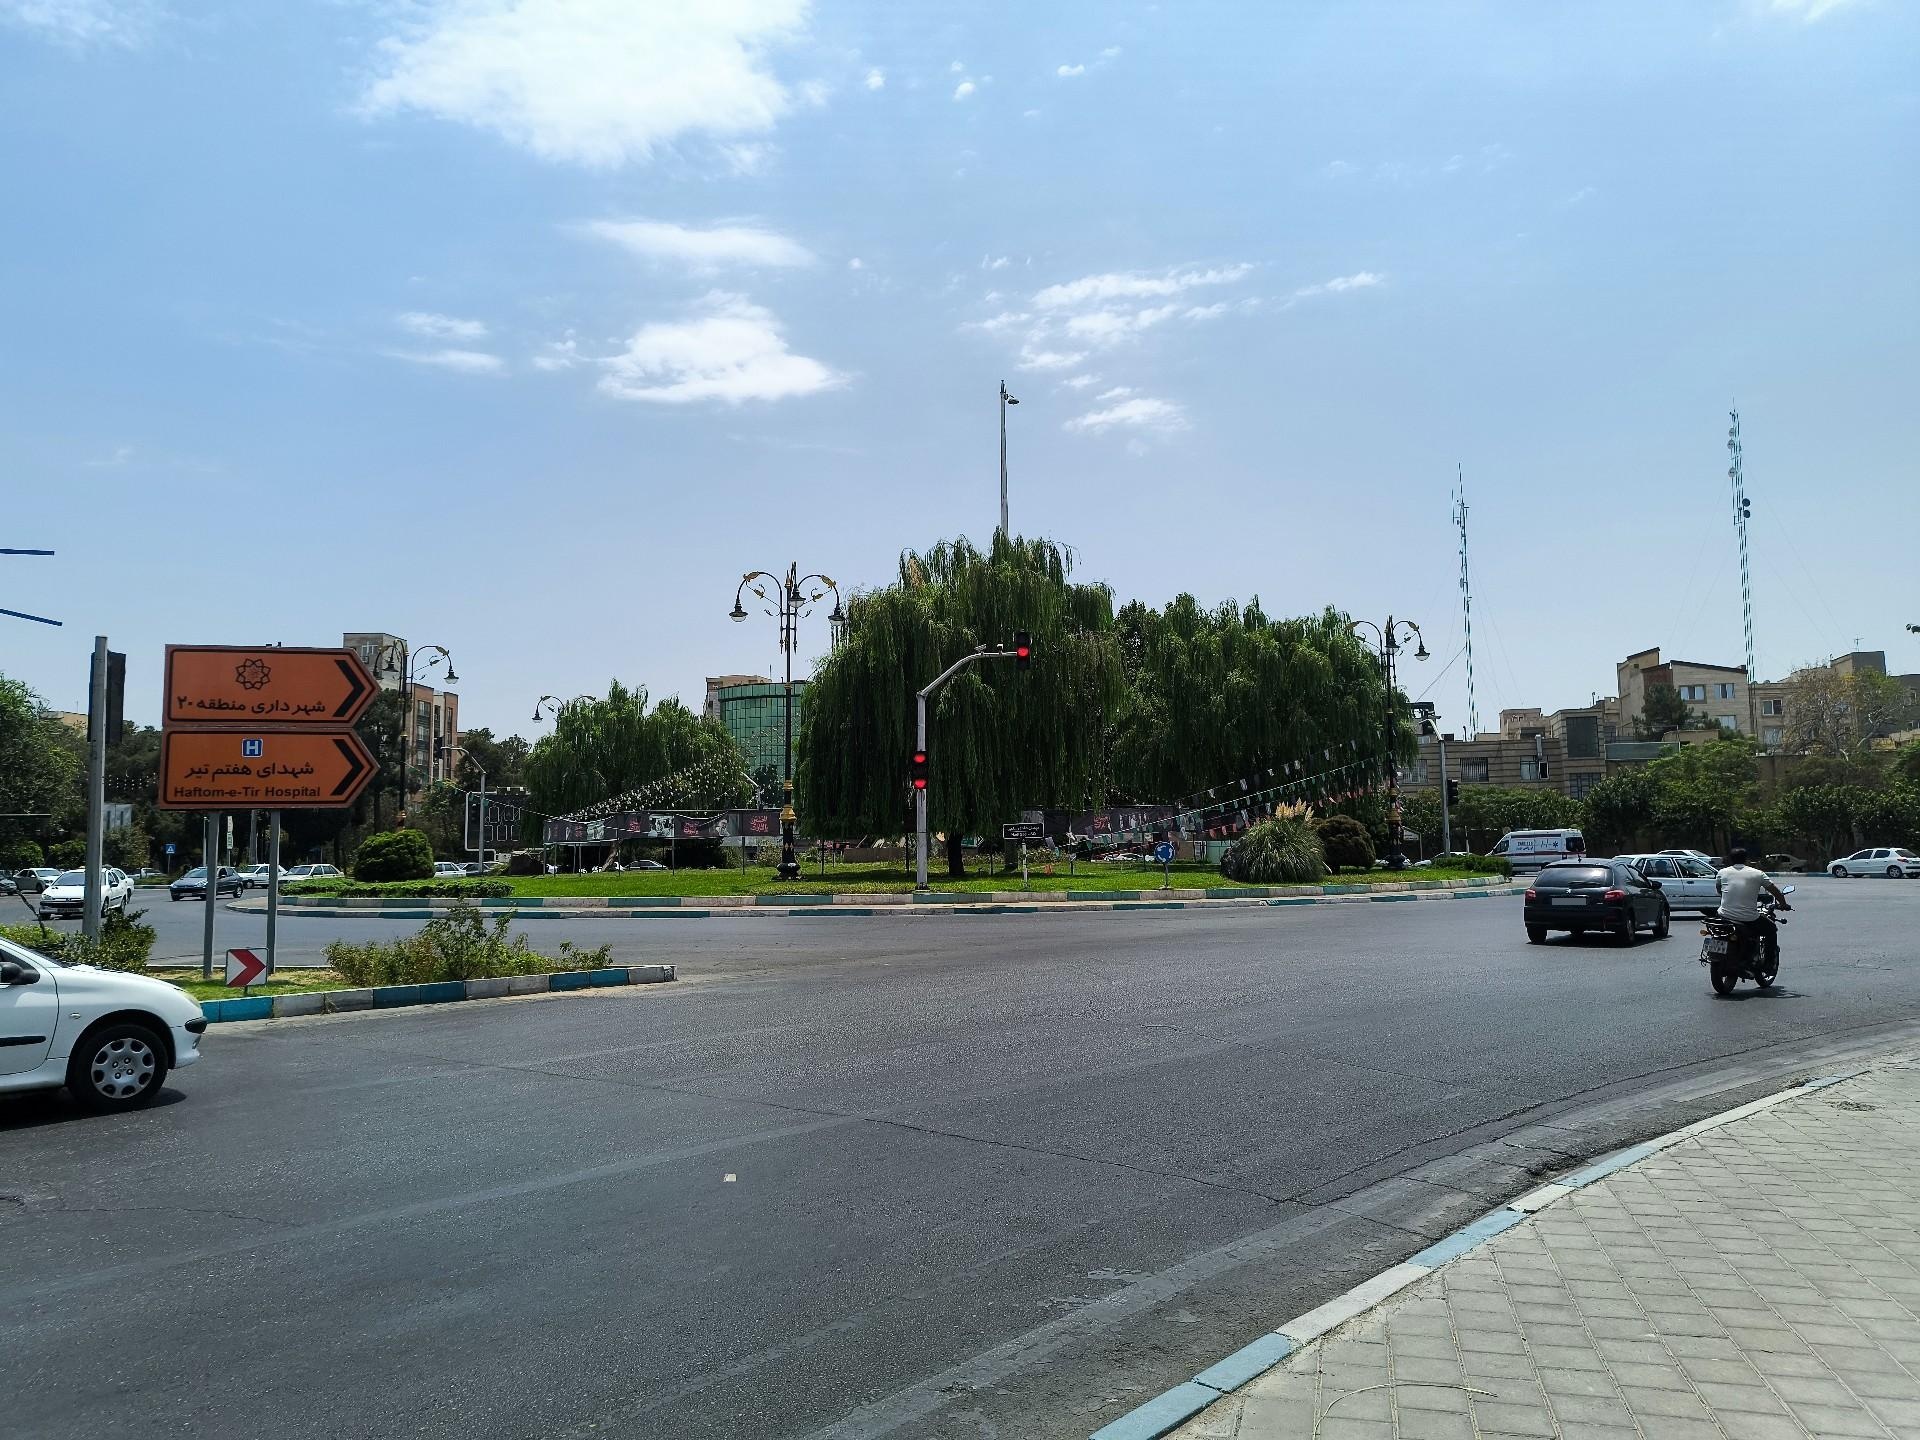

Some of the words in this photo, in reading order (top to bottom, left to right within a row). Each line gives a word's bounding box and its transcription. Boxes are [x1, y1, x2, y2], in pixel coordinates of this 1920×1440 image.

[176, 695, 193, 709] ۲۰
[196, 697, 246, 711] منطقه
[245, 740, 259, 755] H
[183, 763, 209, 779] تیر
[211, 763, 252, 782] هفتم
[256, 761, 315, 778] شهدای
[174, 786, 261, 797] Haftom-e-Tir
[264, 786, 321, 799] Hospital
